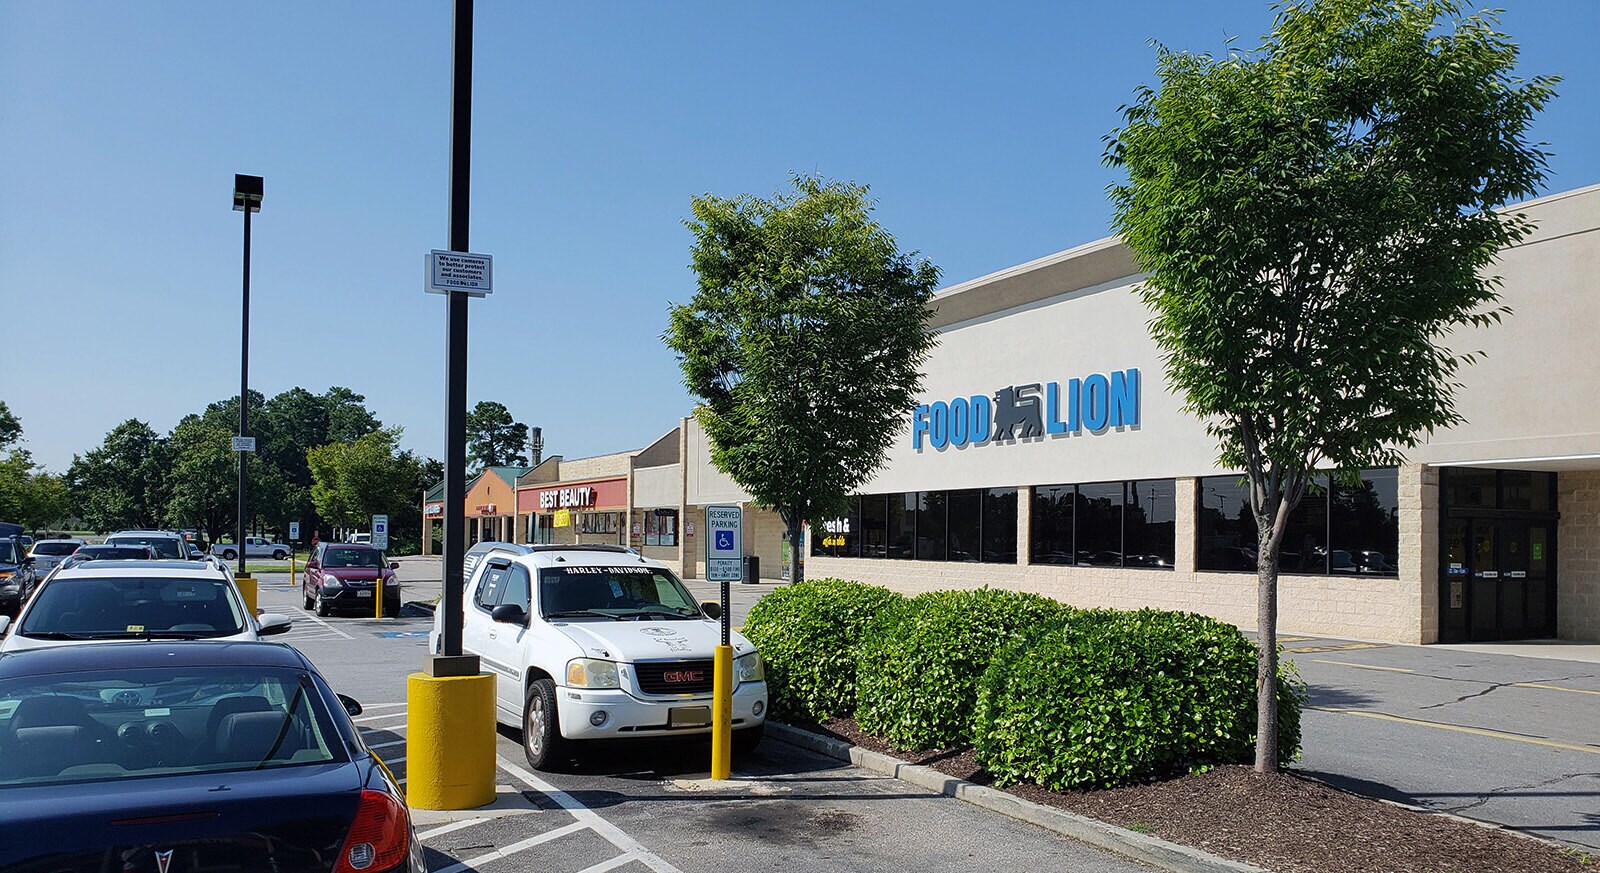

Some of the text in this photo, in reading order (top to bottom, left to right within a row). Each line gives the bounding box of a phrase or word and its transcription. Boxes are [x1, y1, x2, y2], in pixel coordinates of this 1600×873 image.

[913, 368, 1139, 450] FOOD LION
[540, 486, 591, 508] BEST BEAUTY
[709, 510, 740, 519] RESERVED
[711, 520, 738, 529] PARKING
[663, 671, 704, 682] GMC
